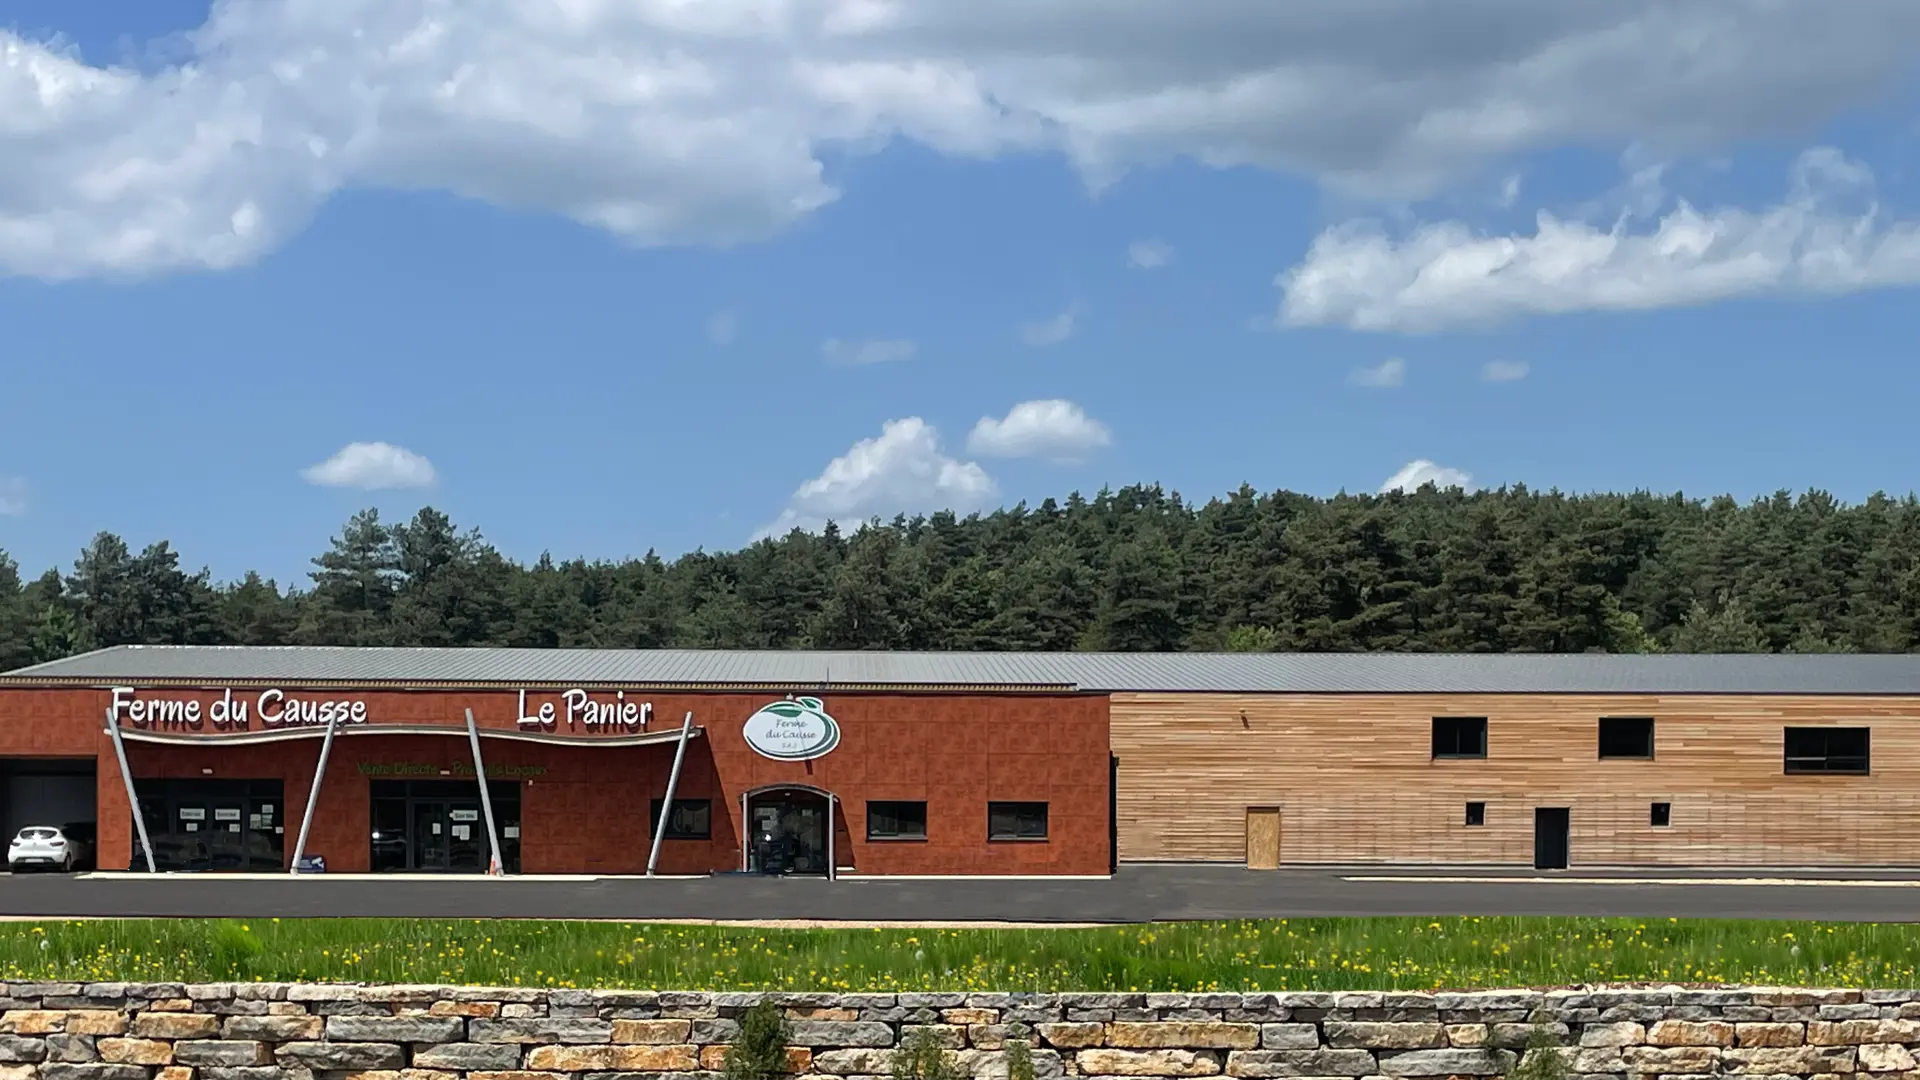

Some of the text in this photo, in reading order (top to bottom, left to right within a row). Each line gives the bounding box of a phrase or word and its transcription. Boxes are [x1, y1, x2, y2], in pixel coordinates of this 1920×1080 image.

[111, 687, 367, 723] Ferme du Causse
[516, 688, 653, 724] Le Panier
[776, 719, 808, 728] Ferme
[766, 729, 817, 739] du Causse
[357, 761, 438, 776] Vente Directe
